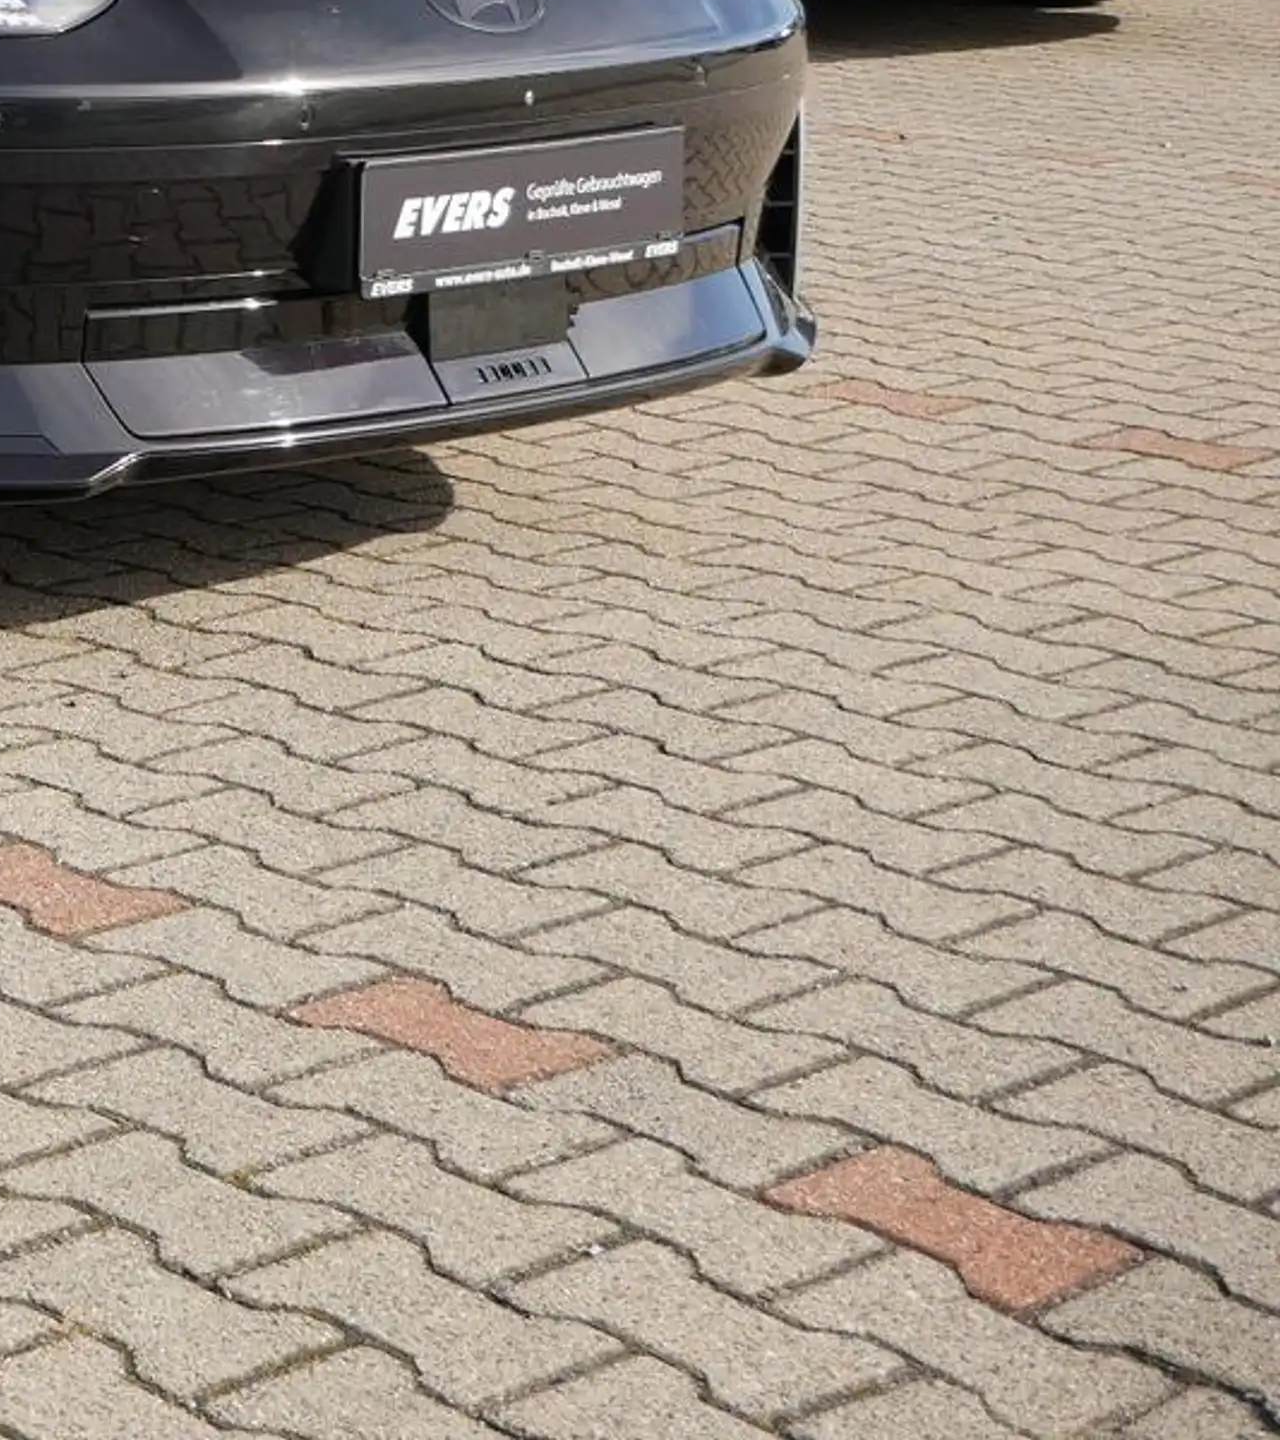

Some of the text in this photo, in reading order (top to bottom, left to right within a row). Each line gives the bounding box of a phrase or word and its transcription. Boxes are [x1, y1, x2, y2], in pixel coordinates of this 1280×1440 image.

[393, 186, 516, 239] EVERS
[526, 169, 662, 203] Geprüfte Gebrauchtwagen
[370, 277, 414, 298] EVERS
[644, 239, 679, 258] EVERS
